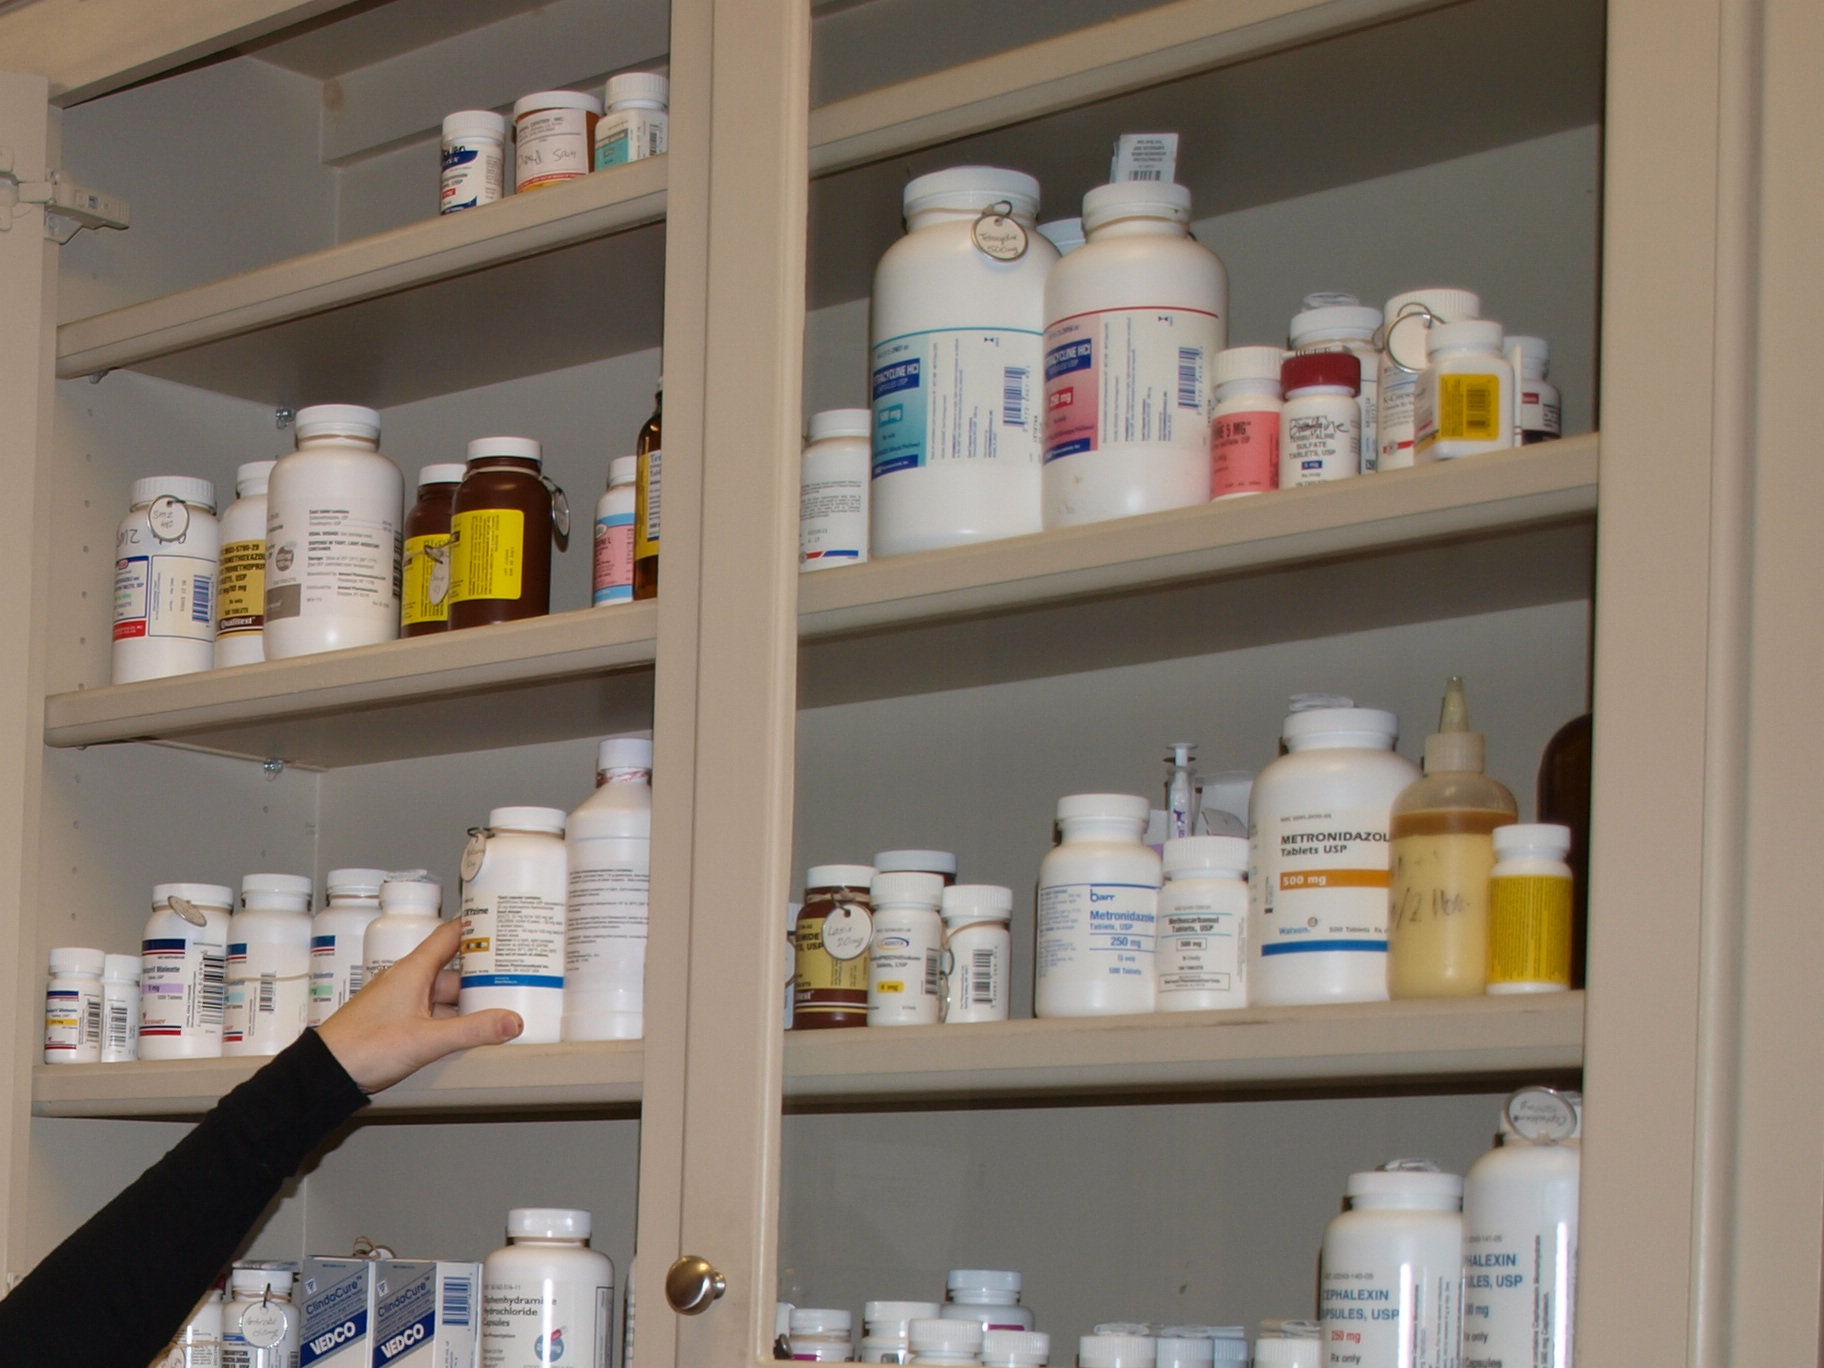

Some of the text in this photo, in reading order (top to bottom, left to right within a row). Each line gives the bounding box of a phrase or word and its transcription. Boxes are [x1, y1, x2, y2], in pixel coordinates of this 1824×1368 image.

[1060, 391, 1072, 405] mg
[1296, 441, 1327, 450] SULFATE
[1289, 449, 1337, 460] TABLETS, USP
[1280, 831, 1391, 846] METRONIDAZOL
[1280, 844, 1348, 858] Tablets USP
[1282, 875, 1327, 887] 500 mg
[1089, 888, 1116, 903] barr
[1089, 910, 1156, 923] Metronidazole
[1119, 923, 1134, 931] USP
[1199, 924, 1215, 932] USP
[1329, 926, 1344, 934] 500
[1345, 926, 1370, 934] Tablets
[1110, 936, 1143, 950] 250 mg
[887, 984, 899, 992] mg
[1496, 1274, 1524, 1288] USP
[1371, 1308, 1400, 1321] USP
[1475, 1304, 1490, 1318] mg
[309, 1320, 357, 1356] VEDCO
[381, 1323, 425, 1359] VEDCO
[1347, 1332, 1362, 1344] mg
[1471, 1331, 1489, 1344] only
[1330, 1353, 1362, 1366] Rx only
